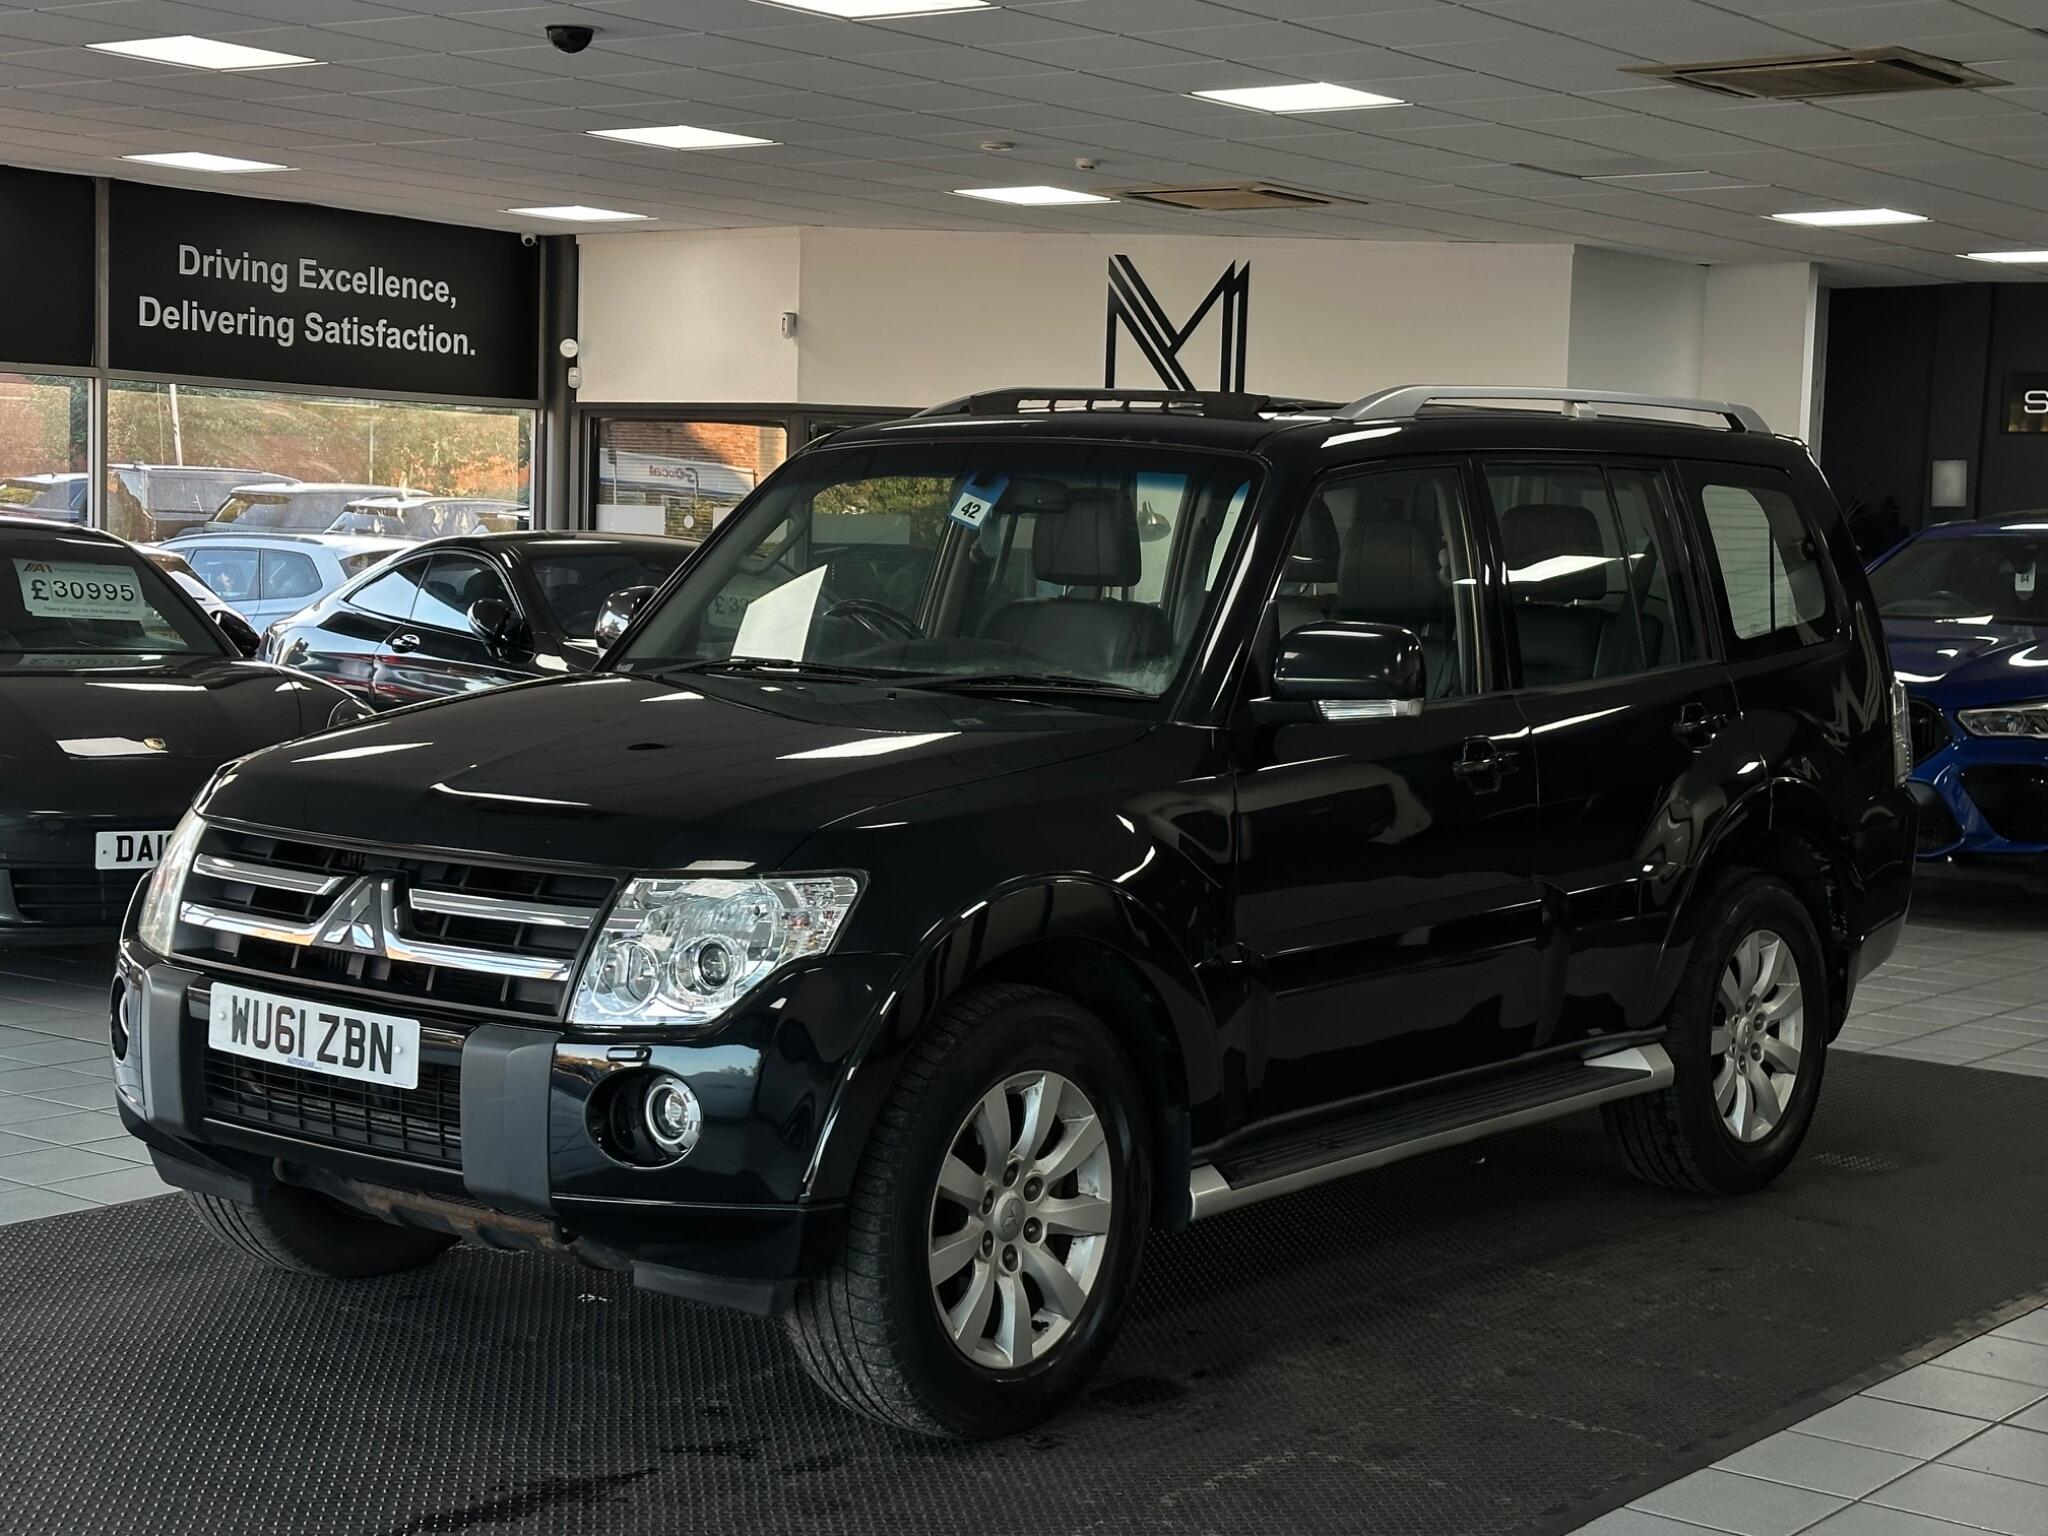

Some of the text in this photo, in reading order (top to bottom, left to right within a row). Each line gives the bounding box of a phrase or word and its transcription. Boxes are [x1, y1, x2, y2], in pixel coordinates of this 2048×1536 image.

[178, 244, 457, 309] Driving Excellence,
[138, 295, 476, 356] Delivering Satisfaction.
[961, 501, 981, 519] 42
[31, 579, 134, 602] £30995
[231, 995, 393, 1075] WU61 ZBN
